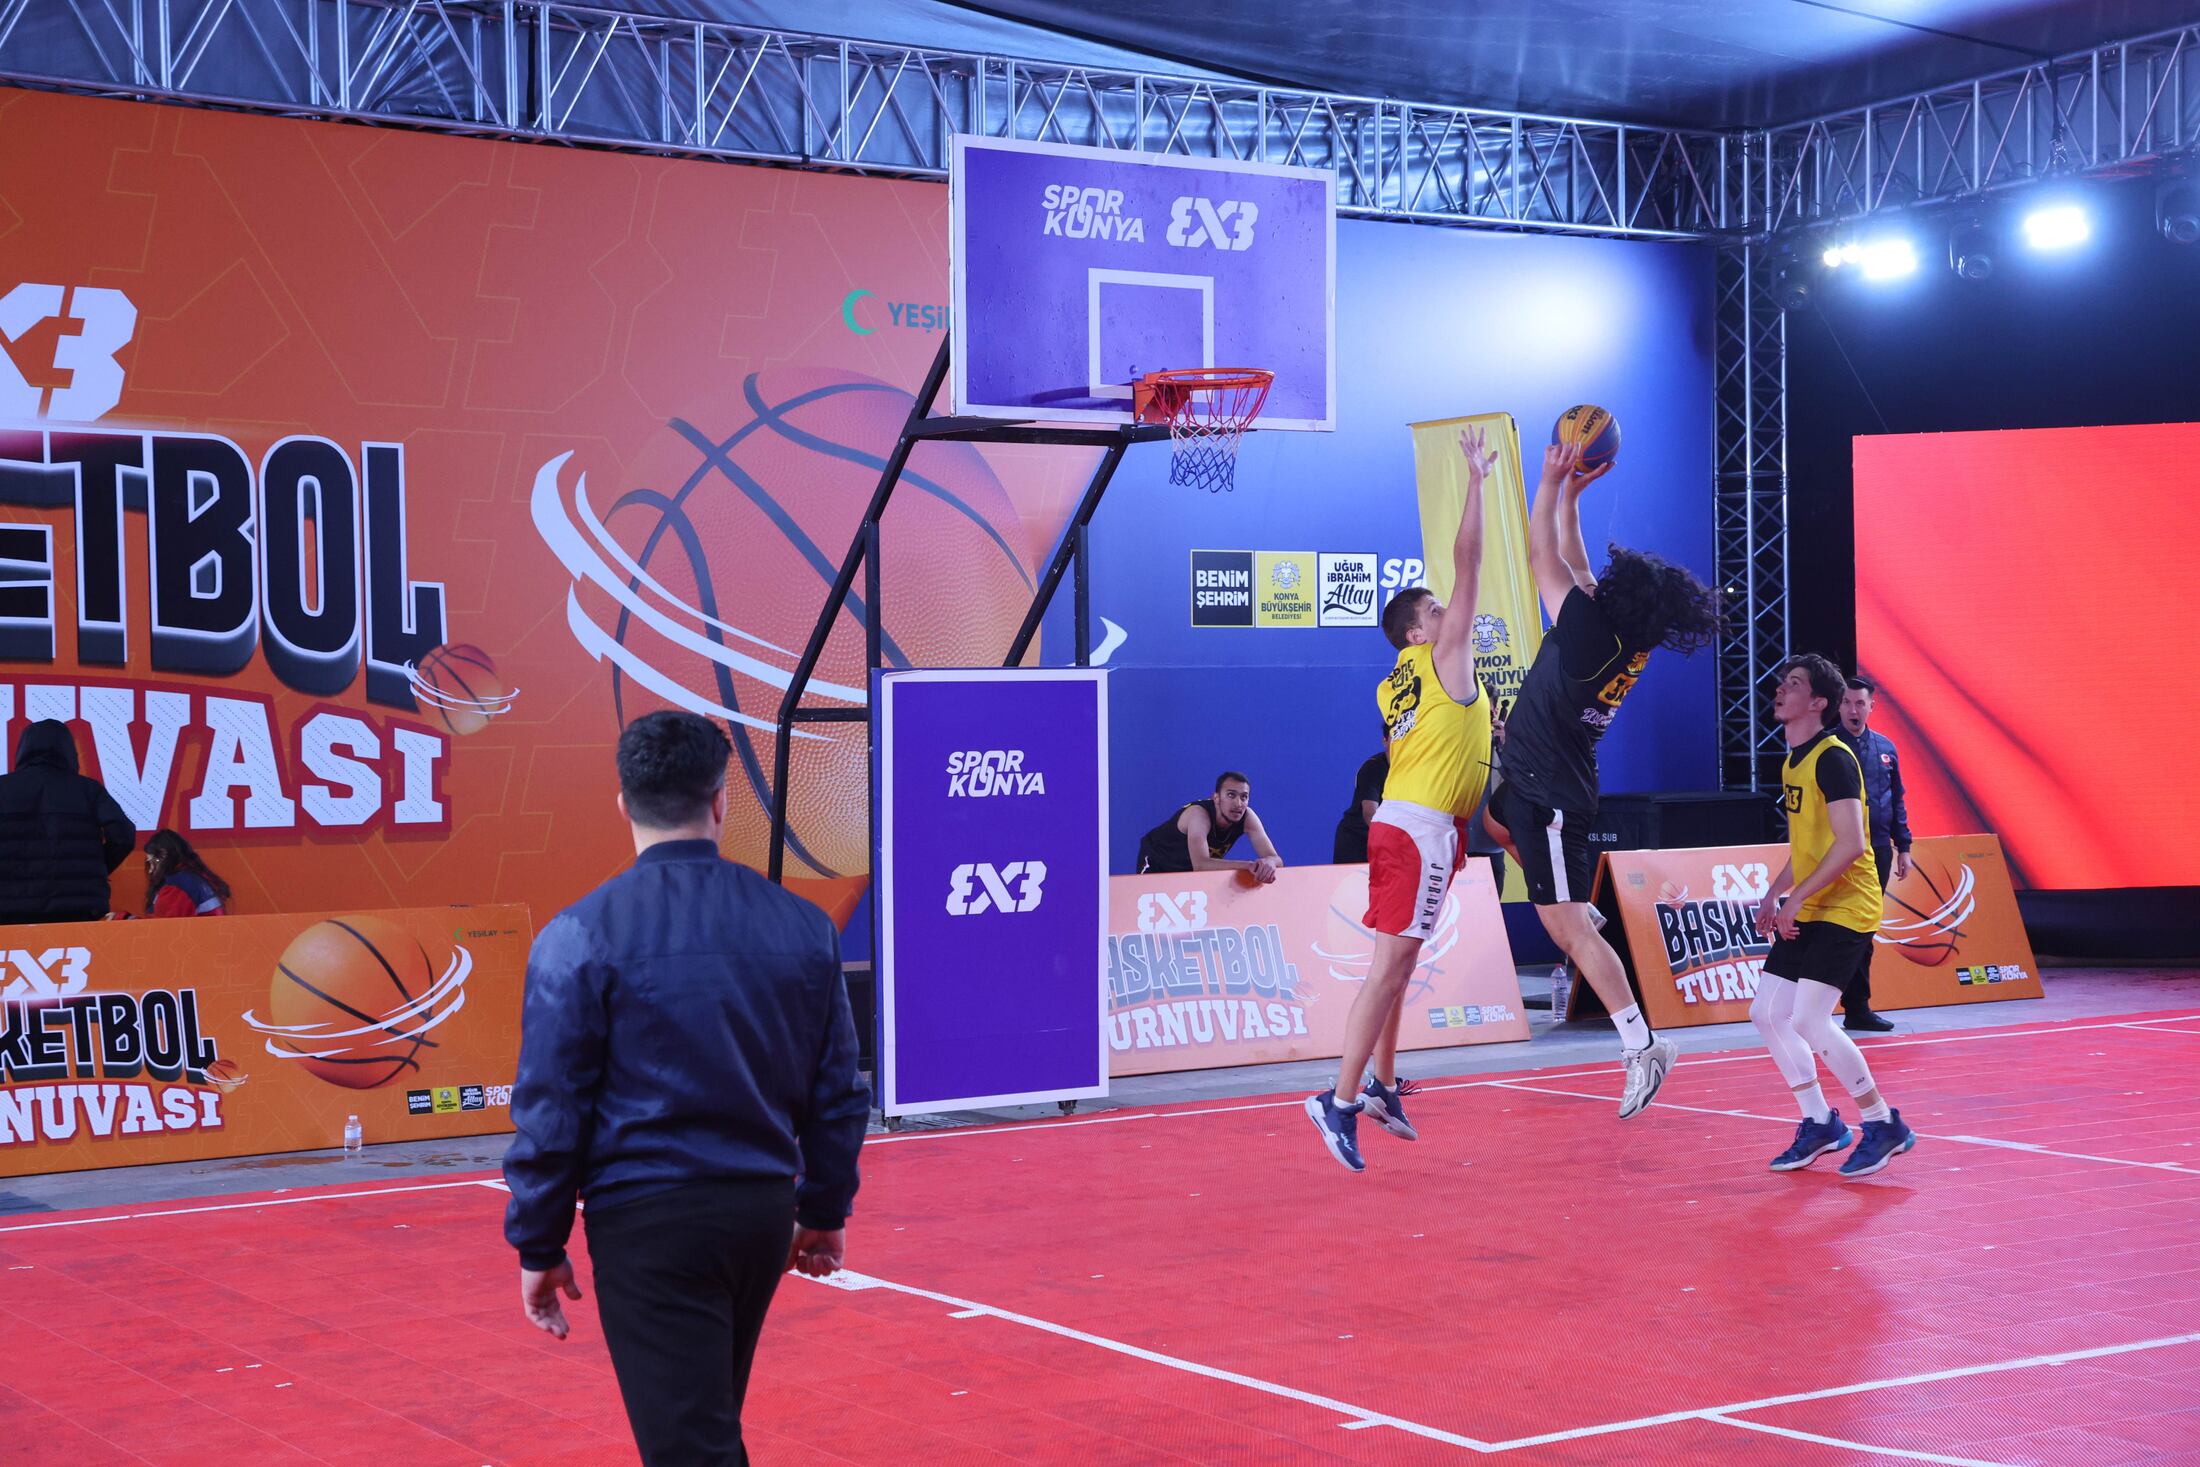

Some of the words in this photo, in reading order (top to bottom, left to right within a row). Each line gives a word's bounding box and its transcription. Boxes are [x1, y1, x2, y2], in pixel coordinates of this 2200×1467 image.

[1042, 185, 1124, 216] SPOR
[1043, 204, 1145, 243] KONYA
[1334, 559, 1363, 572] UĞUR
[1274, 592, 1299, 600] KONYA
[1323, 582, 1374, 615] Altay
[946, 750, 1025, 776] SPOR
[947, 766, 1046, 797] KONYA
[1602, 833, 1617, 841] SUB
[1420, 863, 1445, 930] JORDAN
